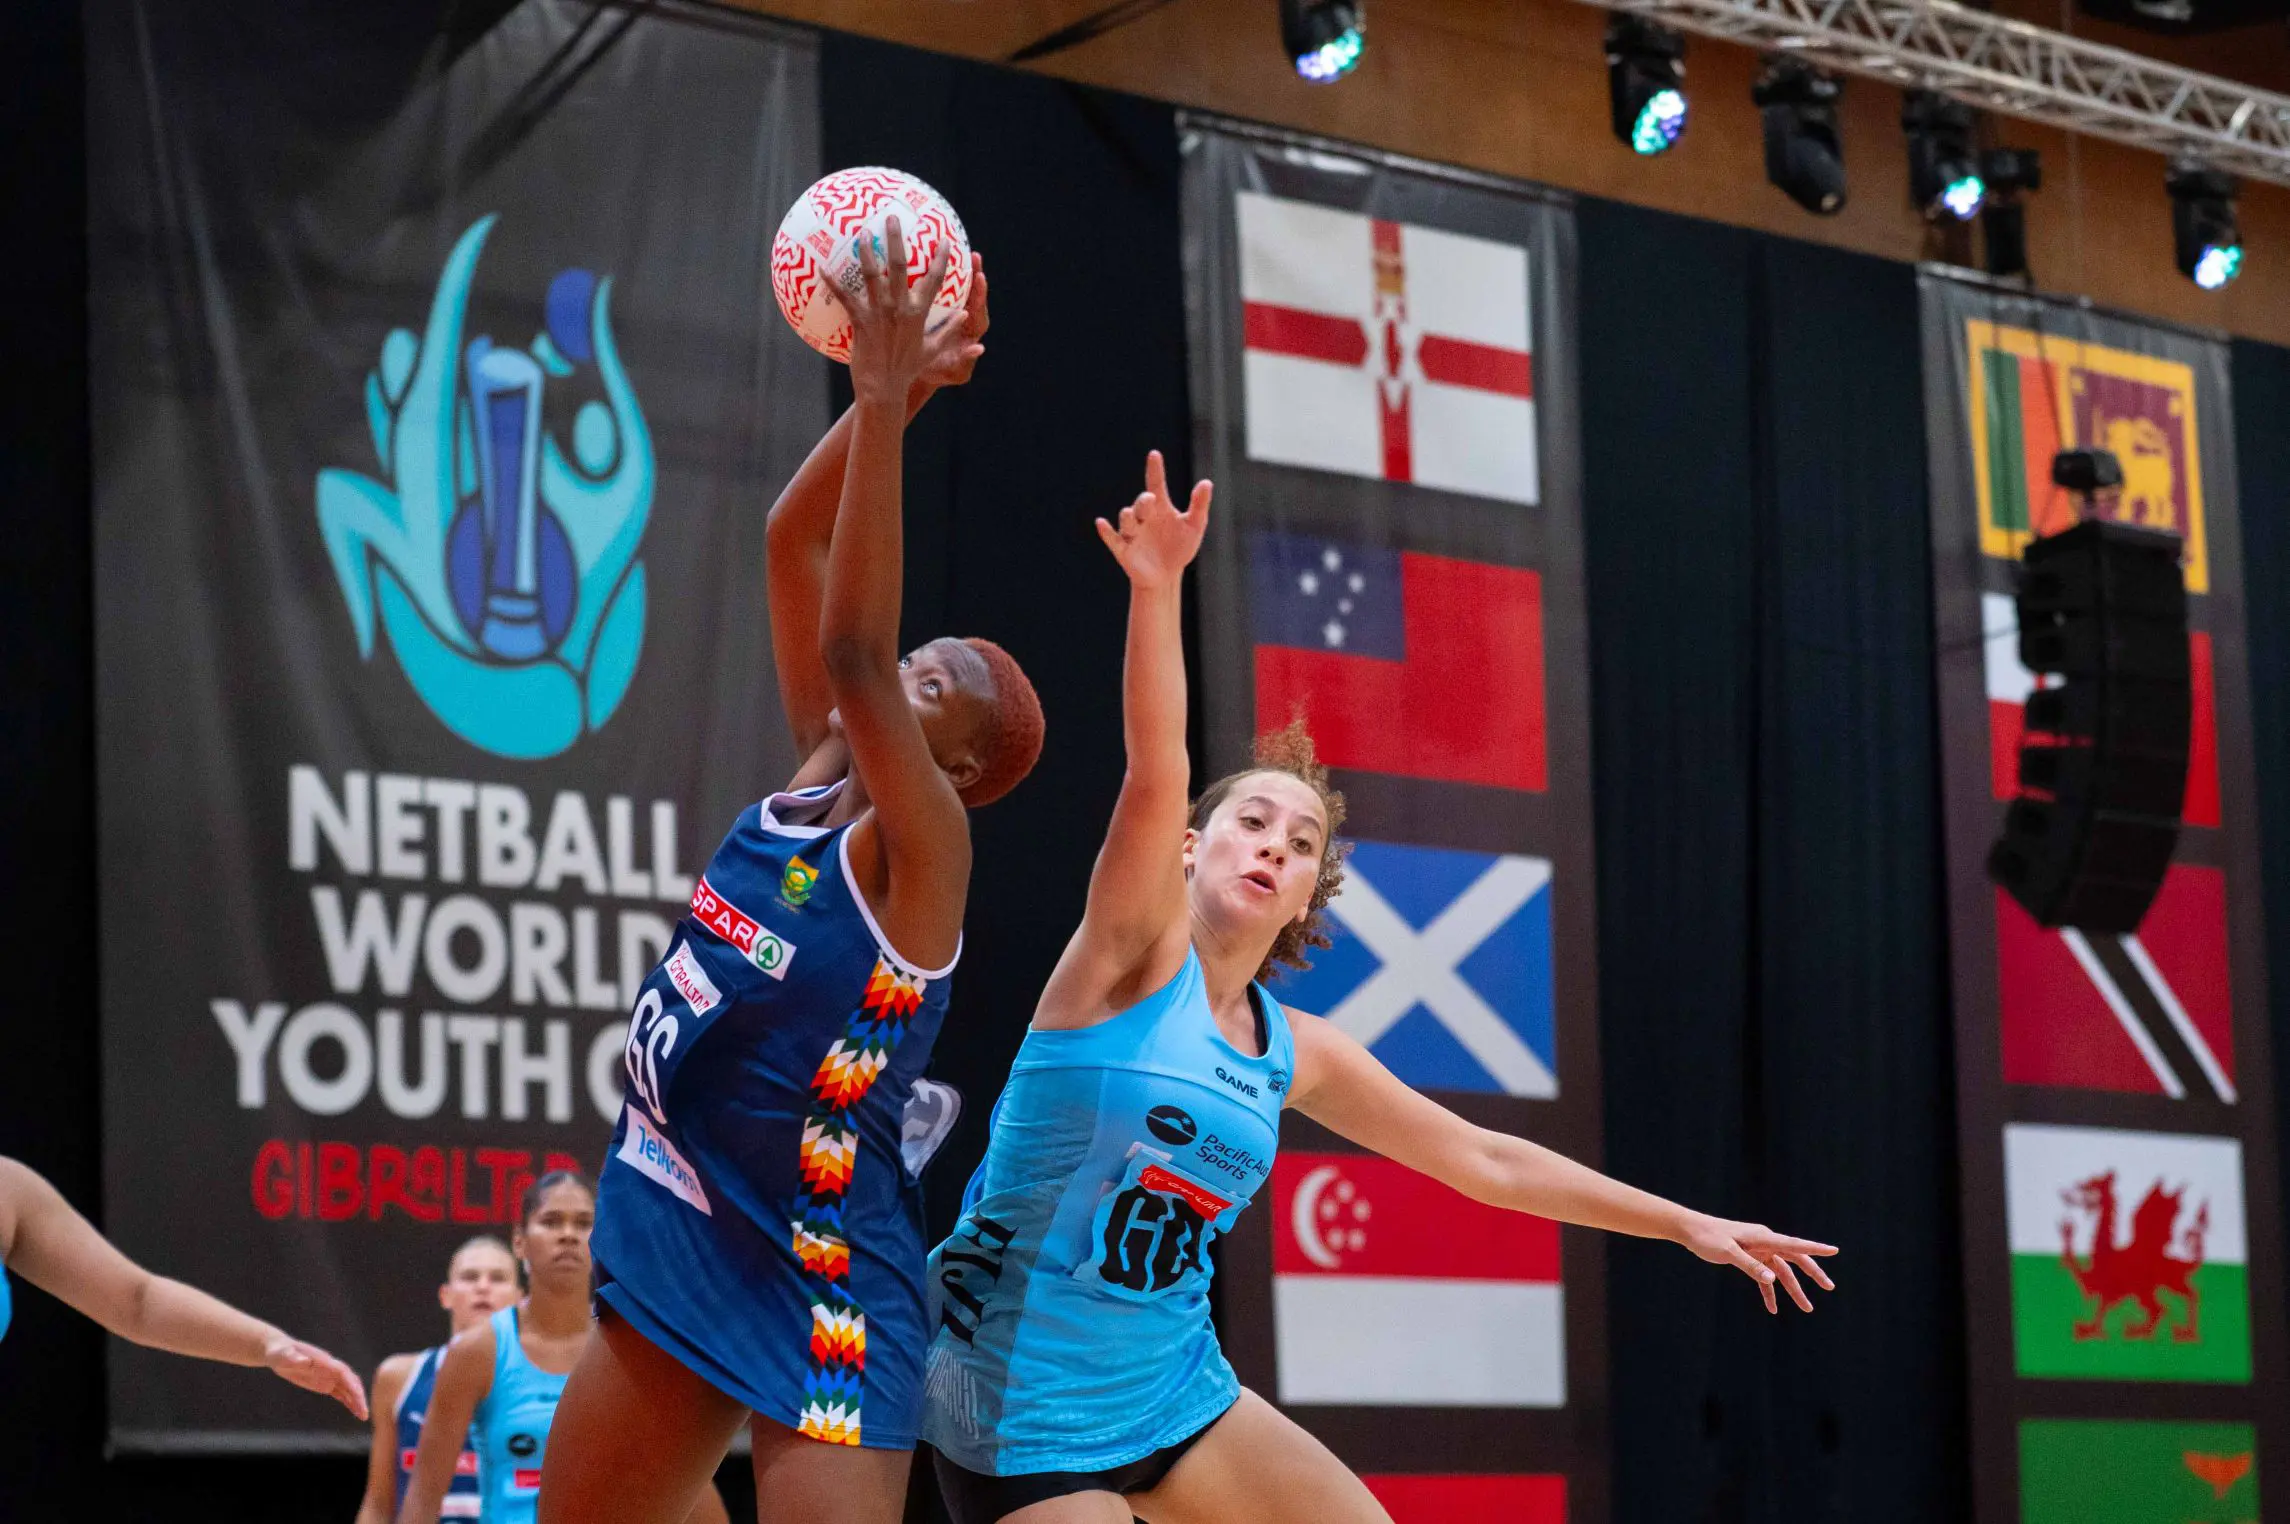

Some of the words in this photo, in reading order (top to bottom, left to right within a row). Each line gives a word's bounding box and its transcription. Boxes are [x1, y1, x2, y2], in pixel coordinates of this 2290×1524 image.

[288, 765, 694, 899] NETBALL
[310, 887, 675, 1011] WORLD
[692, 884, 753, 949] SPAR
[209, 1000, 572, 1122] YOUTH
[625, 988, 679, 1125] GS
[1215, 1067, 1258, 1099] GAME
[251, 1139, 582, 1224] GIBRALT
[638, 1124, 700, 1195] Telkom
[1196, 1145, 1248, 1180] Sports
[1203, 1134, 1269, 1177] PacificAus
